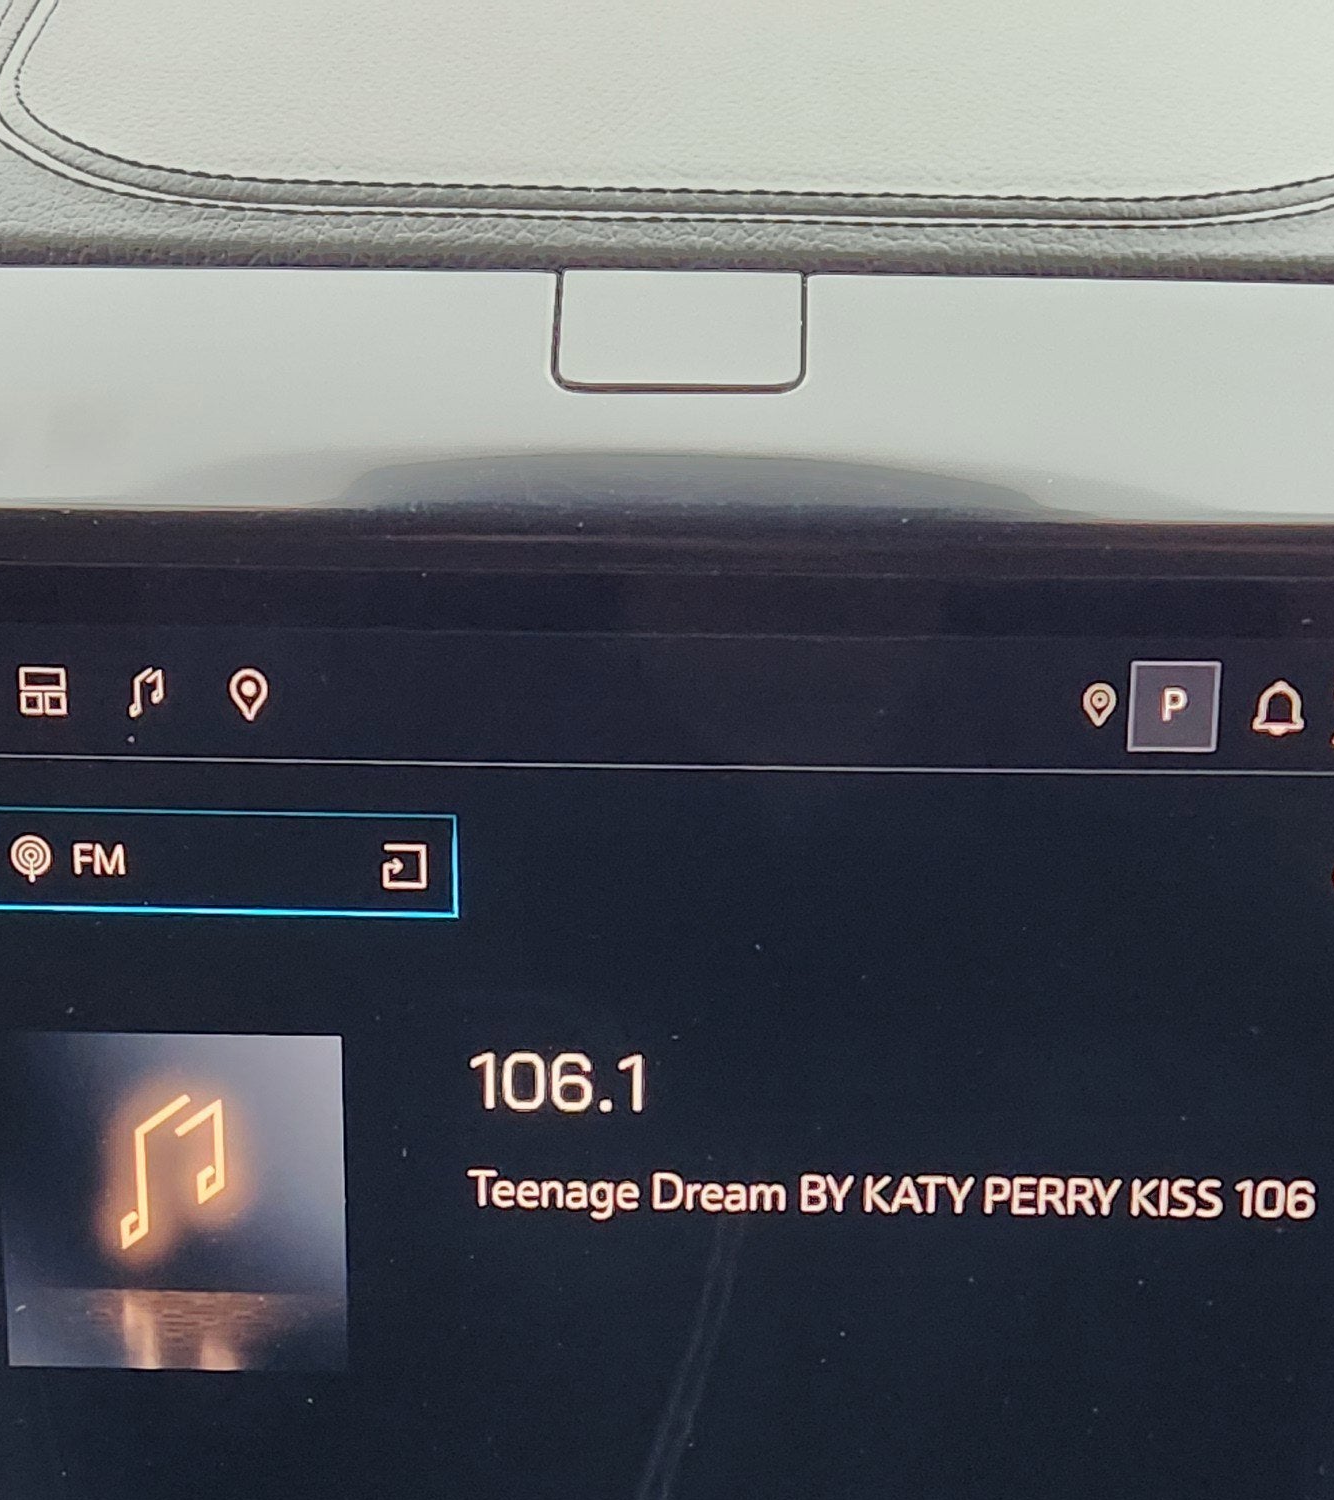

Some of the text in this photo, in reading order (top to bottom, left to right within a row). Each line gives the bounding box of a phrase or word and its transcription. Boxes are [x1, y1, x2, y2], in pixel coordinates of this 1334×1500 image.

[1161, 687, 1188, 722] P
[71, 842, 126, 877] FM
[469, 1051, 646, 1114] 106.1
[466, 1169, 1317, 1221] Teenage Dream BY KATY PERRY KISS 106
